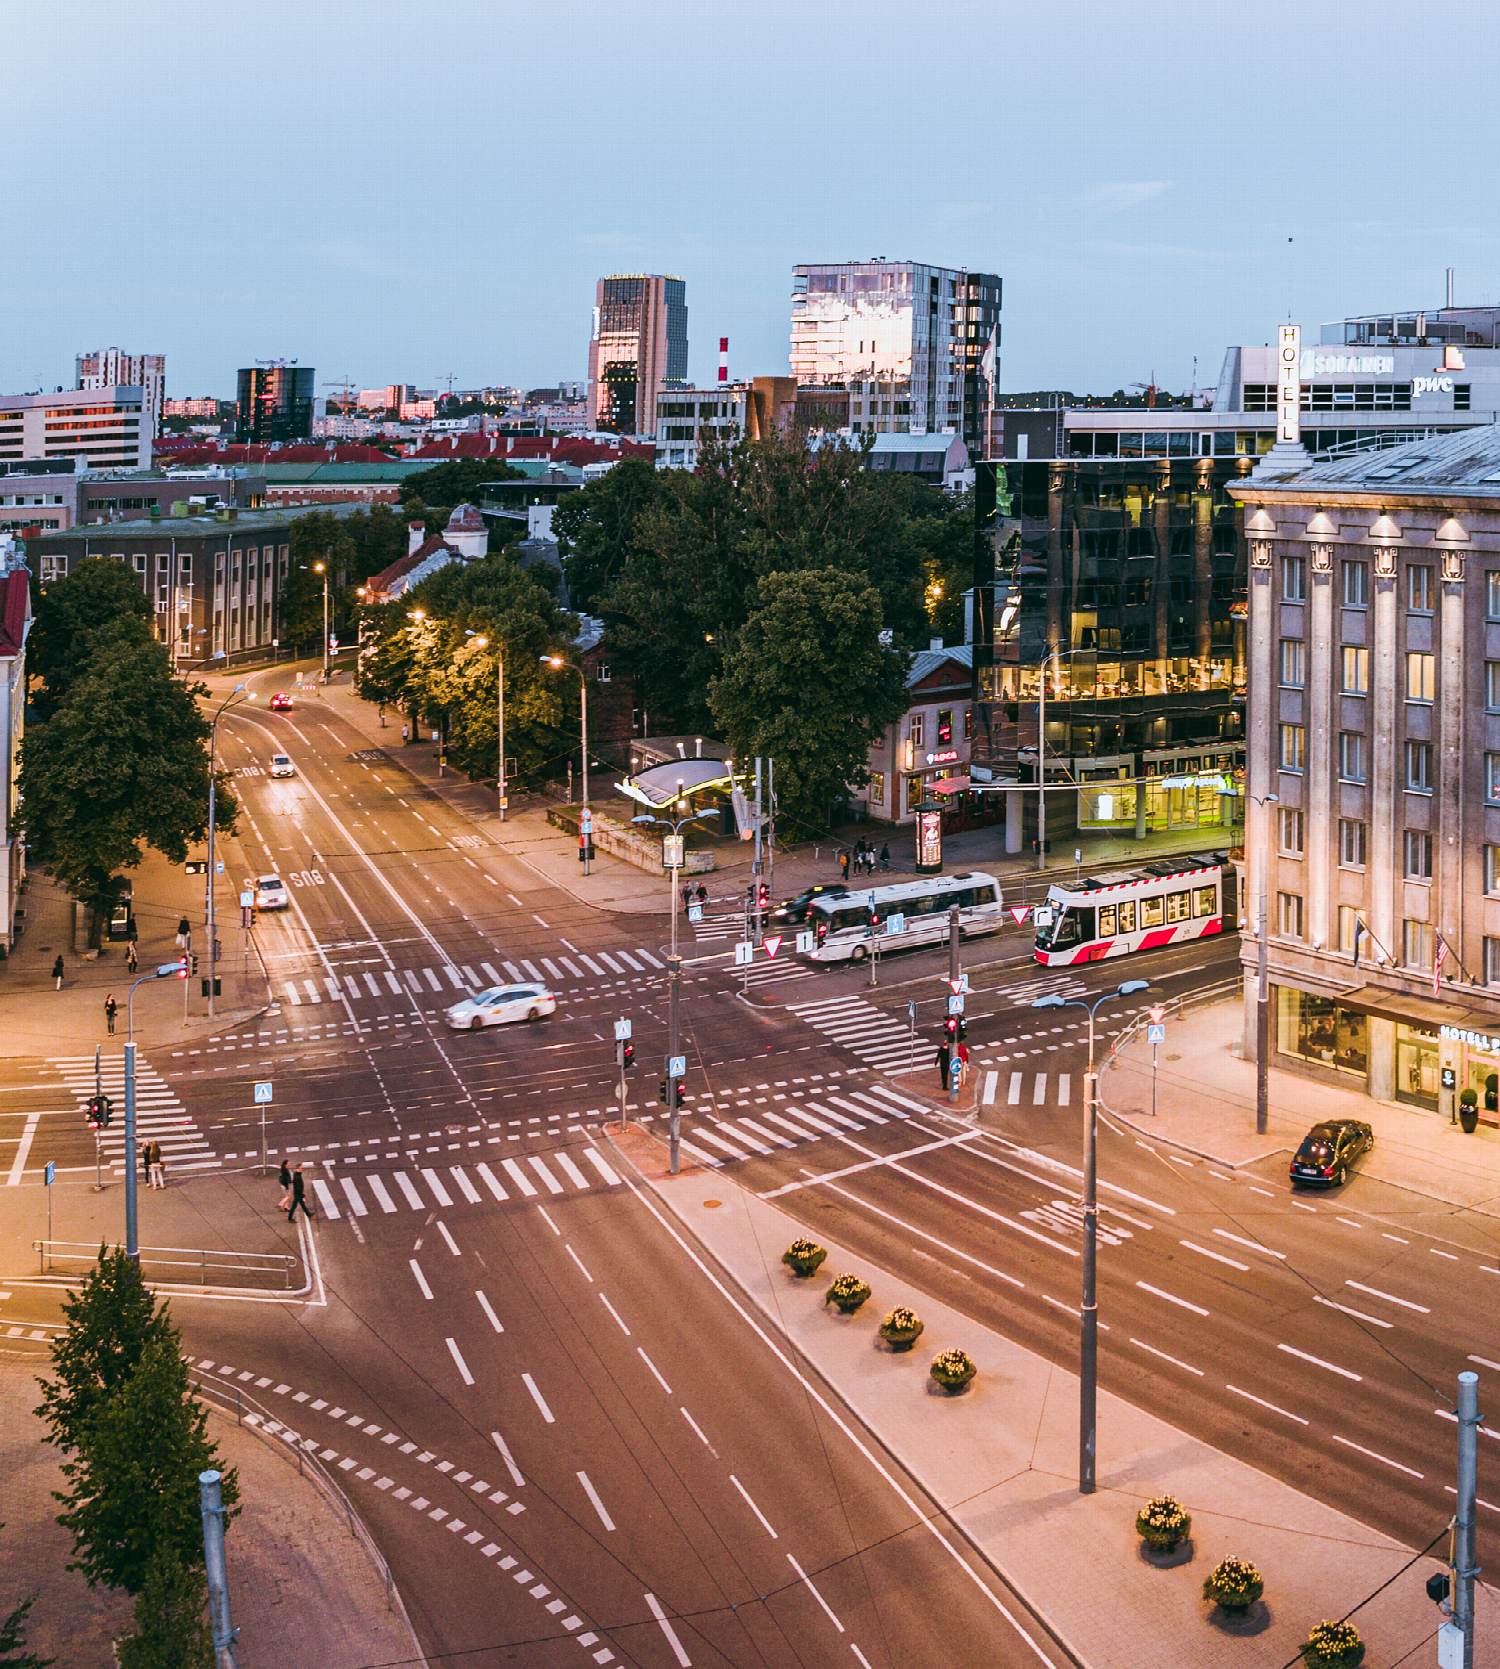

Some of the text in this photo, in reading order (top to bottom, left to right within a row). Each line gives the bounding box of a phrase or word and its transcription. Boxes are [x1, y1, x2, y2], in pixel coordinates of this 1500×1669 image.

[1283, 328, 1296, 440] HOTELL
[1412, 376, 1453, 398] pwc
[289, 869, 326, 888] BUS
[1440, 1025, 1490, 1050] HOTELL
